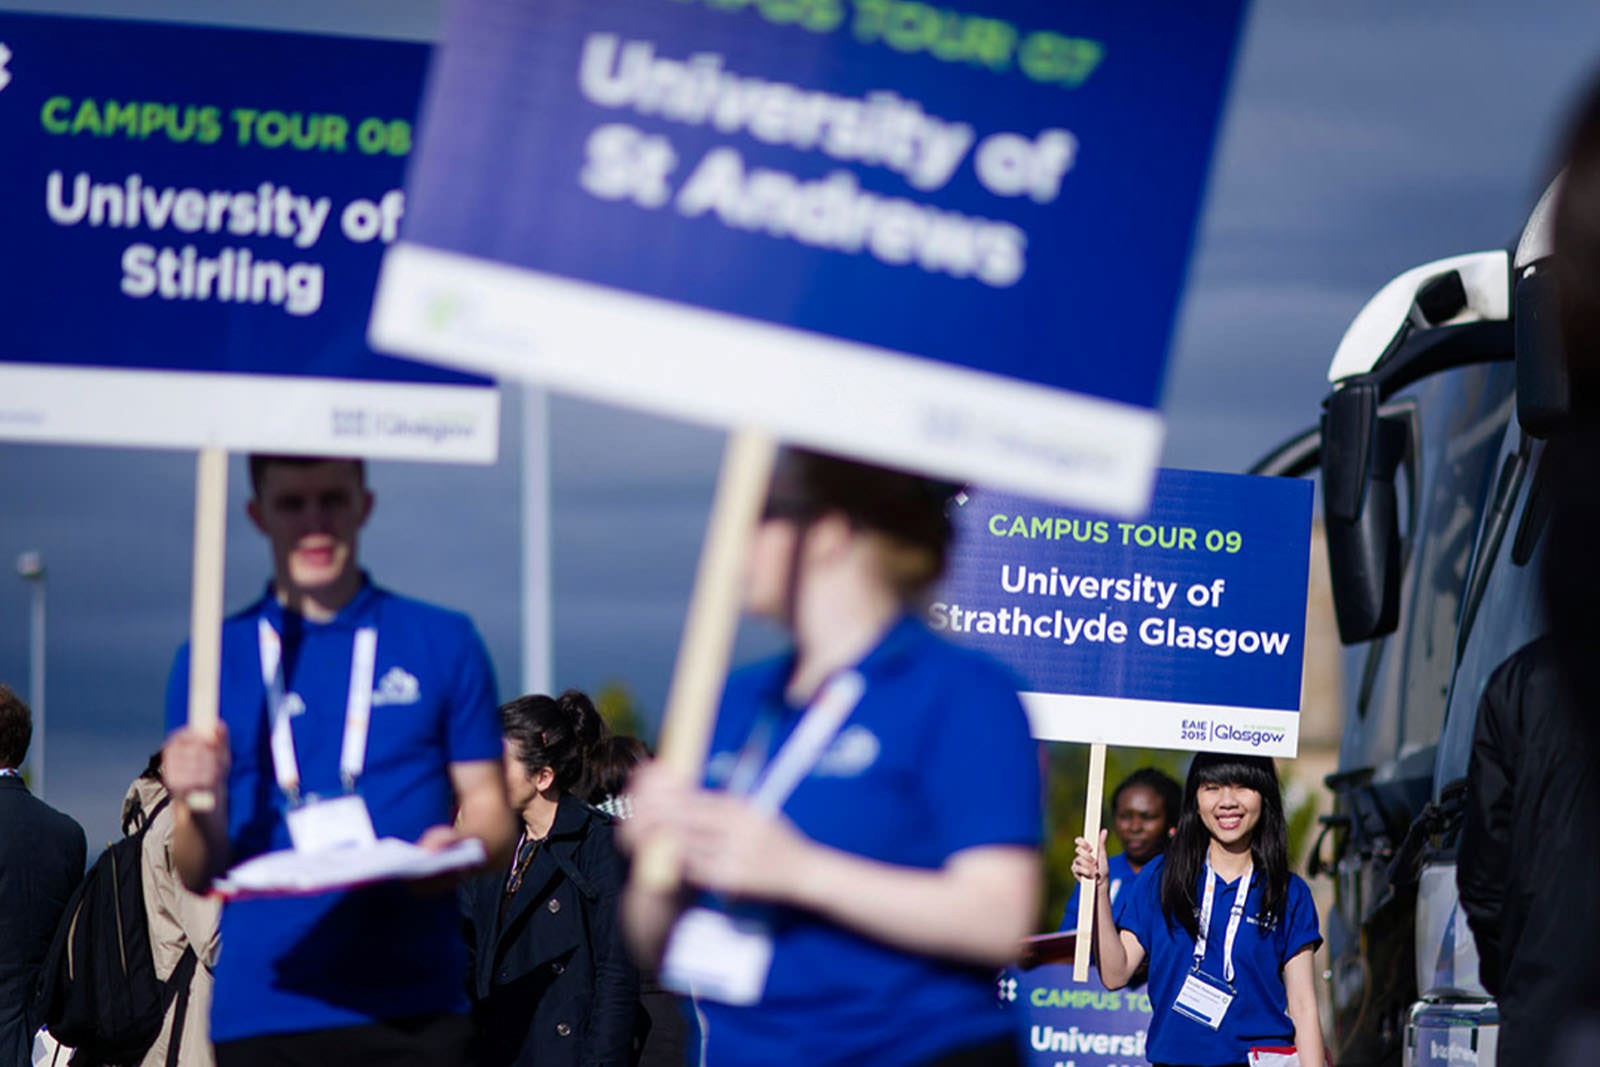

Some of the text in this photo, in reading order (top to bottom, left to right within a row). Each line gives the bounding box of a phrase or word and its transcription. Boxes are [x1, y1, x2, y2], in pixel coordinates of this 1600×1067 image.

[42, 97, 411, 155] CAMPUS TOUR 08
[581, 34, 1078, 202] University of
[47, 171, 404, 246] University of
[581, 124, 1027, 286] St Andrews
[121, 244, 324, 315] Stirling
[988, 514, 1242, 553] CAMPUS TOUR 09
[1001, 565, 1225, 610] University of
[929, 602, 1290, 656] Strathclyde Glasgow
[1181, 730, 1206, 740] 2015
[1182, 720, 1207, 730] EAIE
[1215, 724, 1285, 746] Glasgow
[1030, 988, 1121, 1011] CAMPUS
[1031, 1025, 1147, 1056] Universi
